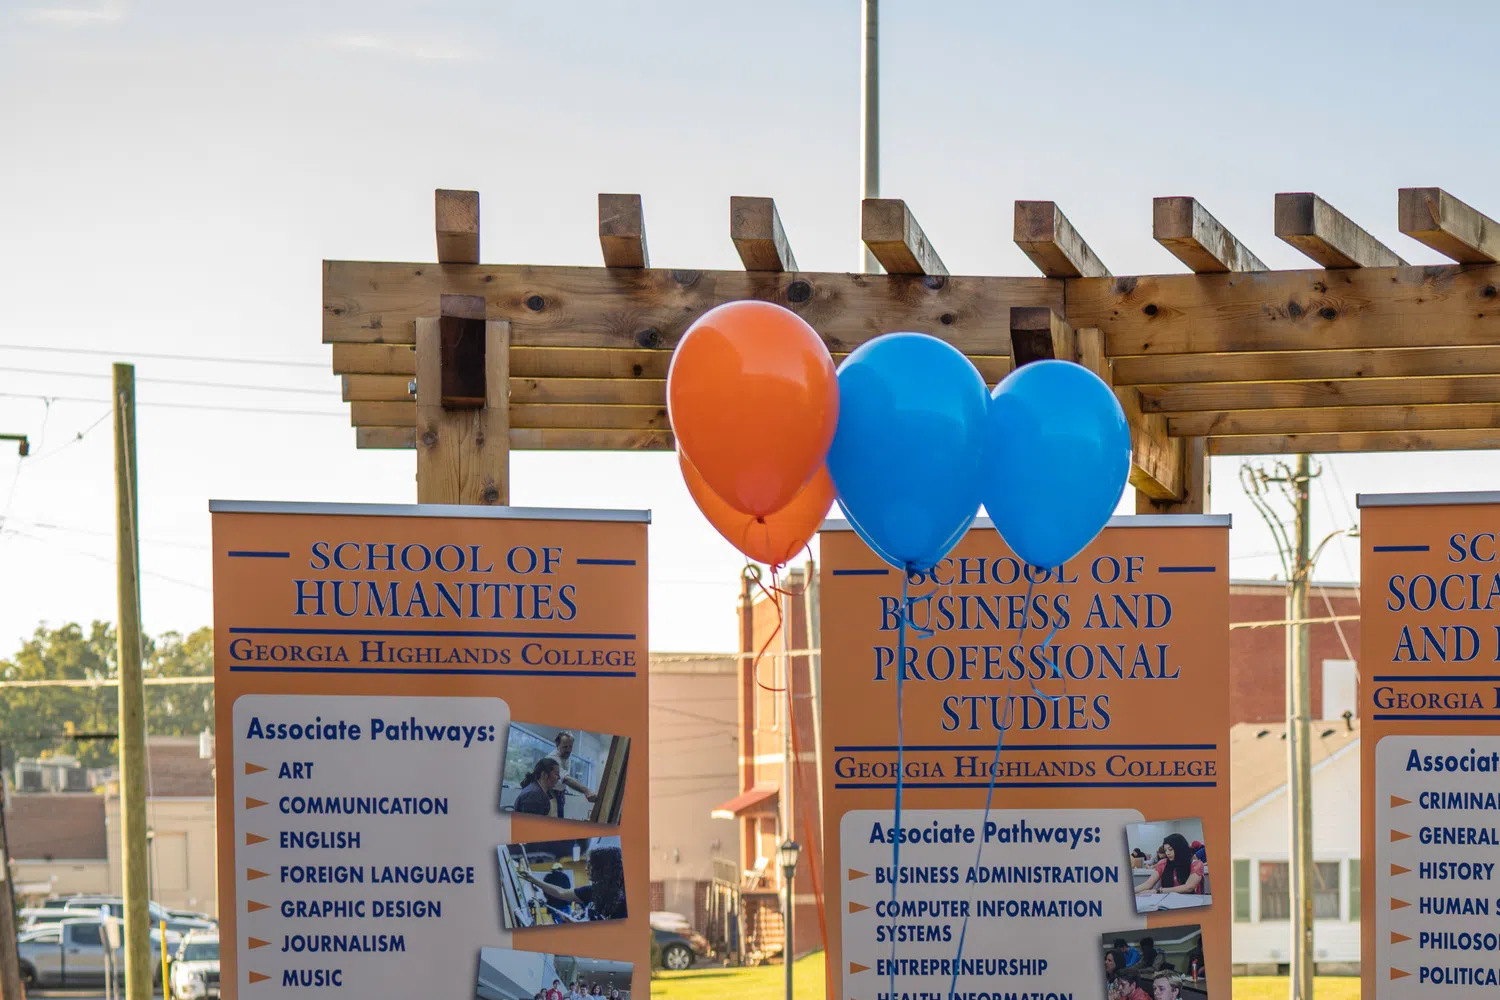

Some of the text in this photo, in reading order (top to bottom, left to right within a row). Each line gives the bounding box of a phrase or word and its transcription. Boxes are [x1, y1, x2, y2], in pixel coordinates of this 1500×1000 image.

[309, 541, 563, 574] SCHOOL OF
[1092, 555, 1145, 584] OF
[293, 579, 577, 621] HUMANITIES
[879, 593, 1172, 631] BUSINESS AND
[1392, 624, 1480, 662] AND
[872, 643, 1180, 682] PROFESSIONAL
[941, 694, 1111, 732] STUDIES
[246, 715, 494, 748] Associate Pathways:
[278, 761, 313, 779] ART
[278, 795, 448, 814] COMMUNICATION
[279, 830, 360, 849] ENGLISH
[868, 820, 1100, 849] Associate Pathways:
[1418, 826, 1499, 845] GENERAL
[280, 865, 474, 884] FOREIGN LANGUAGE
[874, 865, 1118, 884] BUSINESS ADMINISTRATION
[1419, 861, 1494, 880] HISTORY
[280, 899, 441, 918] GRAPHIC DESIGN
[875, 899, 1102, 917] COMPUTER INFORMATION
[1419, 896, 1488, 915] HUMAN
[875, 923, 951, 942] SYSTEMS
[281, 934, 405, 952] JOURNALISM
[876, 957, 1048, 977] ENTREPRENEURSHIP
[281, 968, 342, 987] MUSIC
